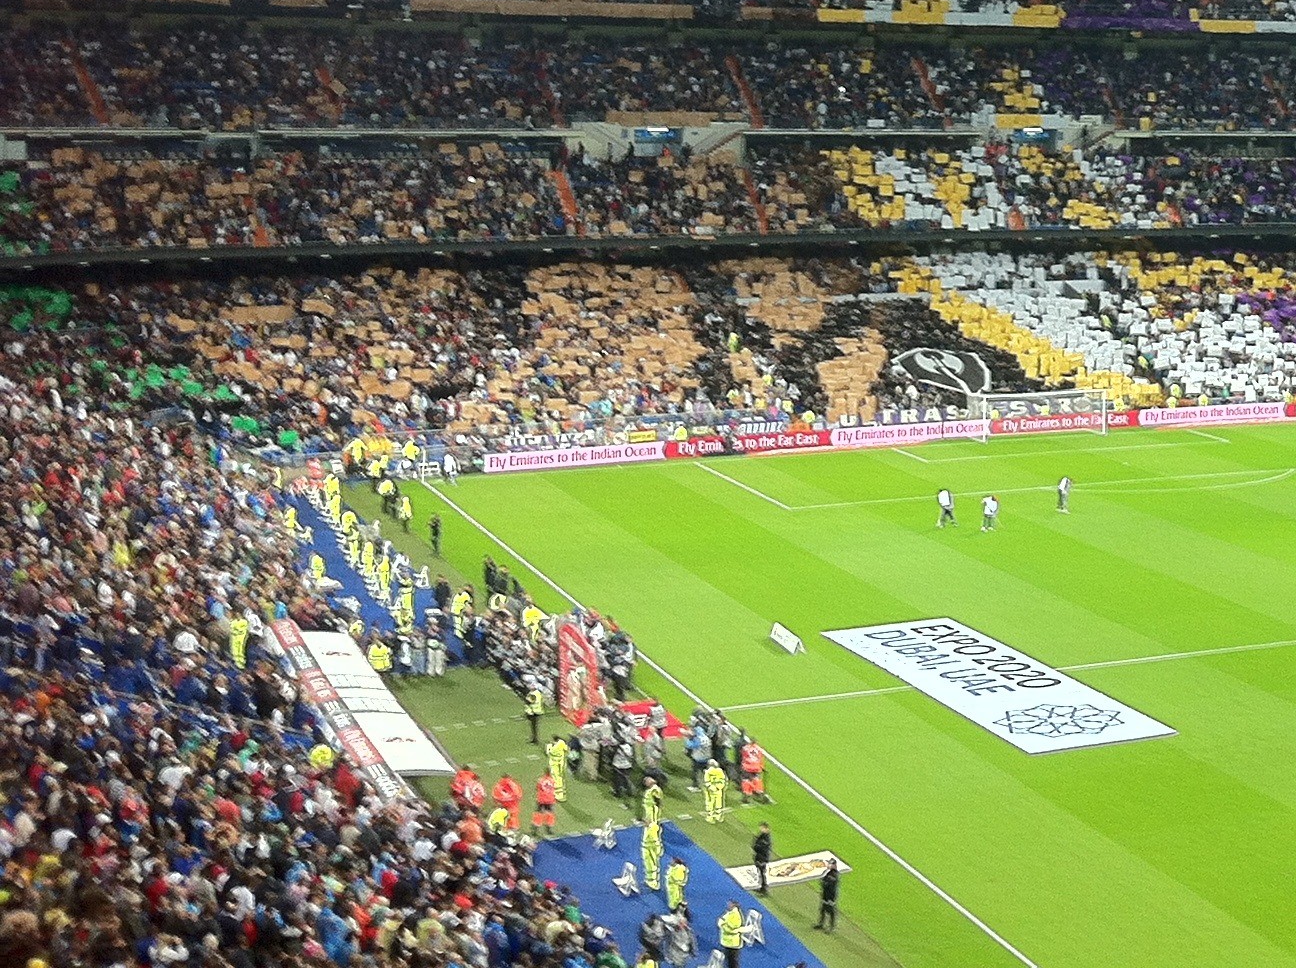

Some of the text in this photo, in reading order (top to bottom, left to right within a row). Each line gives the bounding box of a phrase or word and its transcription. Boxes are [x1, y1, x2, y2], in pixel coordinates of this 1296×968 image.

[1003, 413, 1129, 433] Fly Emirates to the Fa East
[1145, 406, 1279, 422] Fly Emirates to the Indian Ocean
[678, 441, 696, 456] Fly
[745, 438, 757, 449] to
[759, 436, 776, 447] the
[778, 435, 794, 446] Far
[796, 433, 819, 445] East
[837, 423, 985, 443] Fly Emirates to the Indian Ocean
[489, 445, 657, 470] Fly Emirates to the Indian Ocean
[910, 624, 1061, 688] EXPO 2020
[939, 668, 1016, 696] UAE
